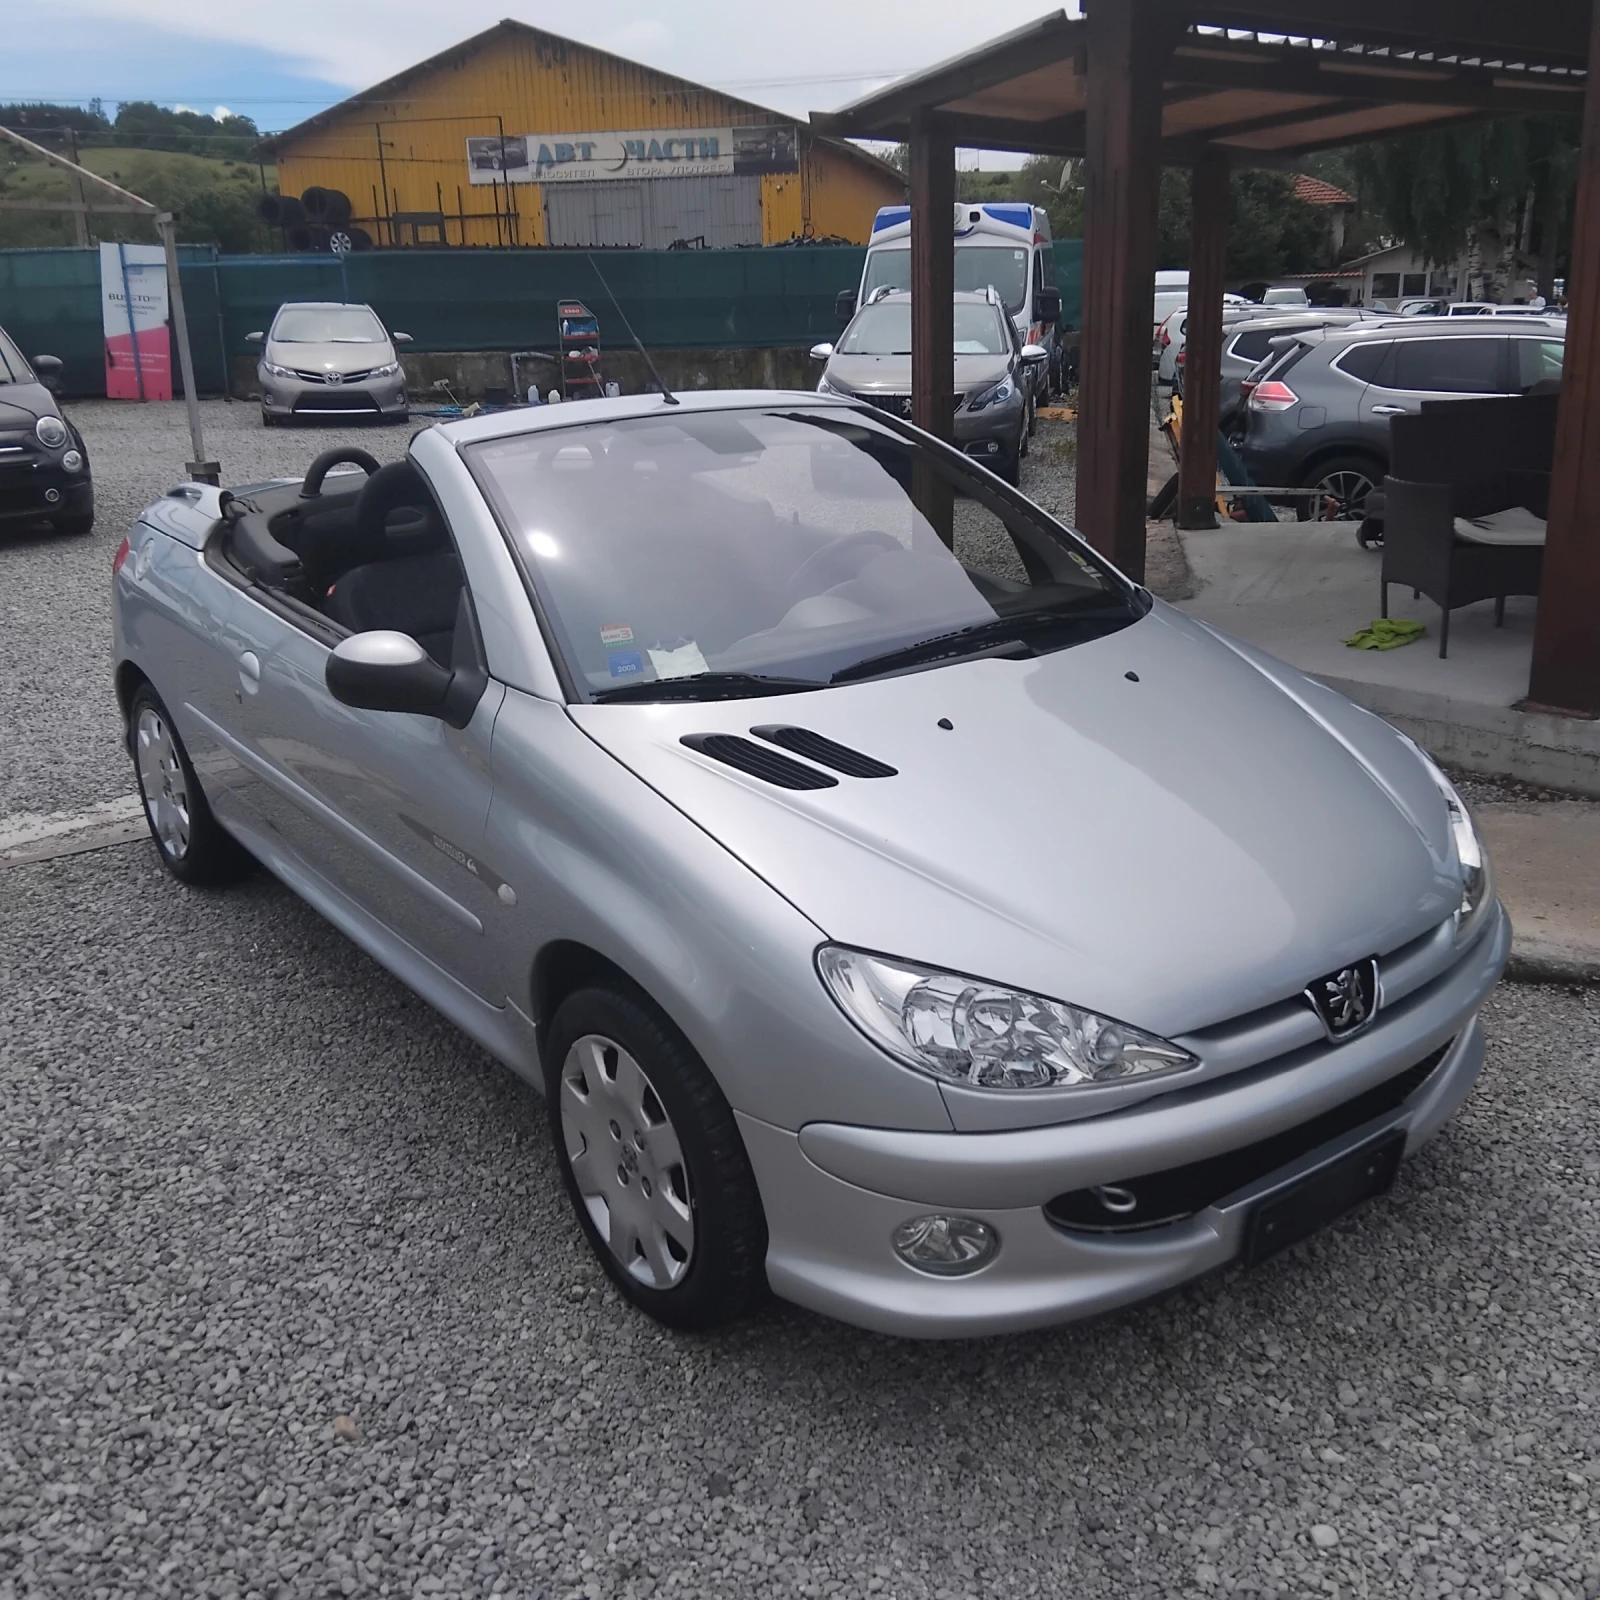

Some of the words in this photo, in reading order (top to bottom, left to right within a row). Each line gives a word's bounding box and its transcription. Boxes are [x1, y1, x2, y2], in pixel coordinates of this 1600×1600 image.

[625, 136, 719, 162] ЧАСТИ
[627, 166, 665, 177] ВТОРА
[670, 163, 732, 175] УПОТРЕБА
[620, 629, 631, 639] 3
